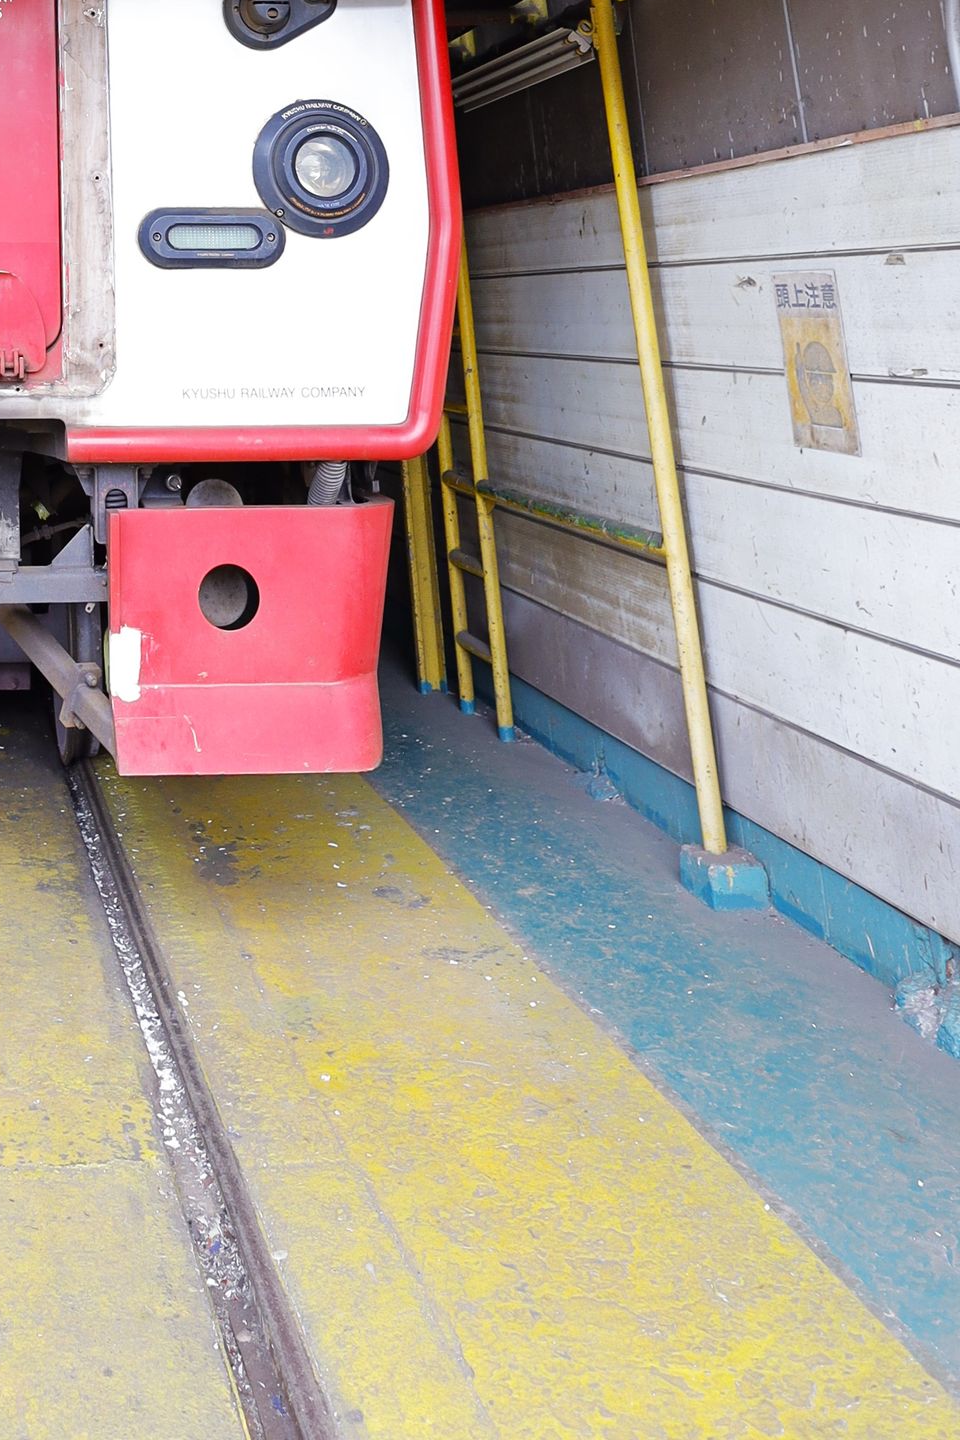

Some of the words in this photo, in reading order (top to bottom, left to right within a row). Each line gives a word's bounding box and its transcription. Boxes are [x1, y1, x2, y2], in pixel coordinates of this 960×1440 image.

[775, 282, 837, 309] 頭上注意
[182, 387, 236, 400] KYUSHU
[240, 387, 296, 399] RAILWAY
[301, 386, 366, 398] COMPANY
